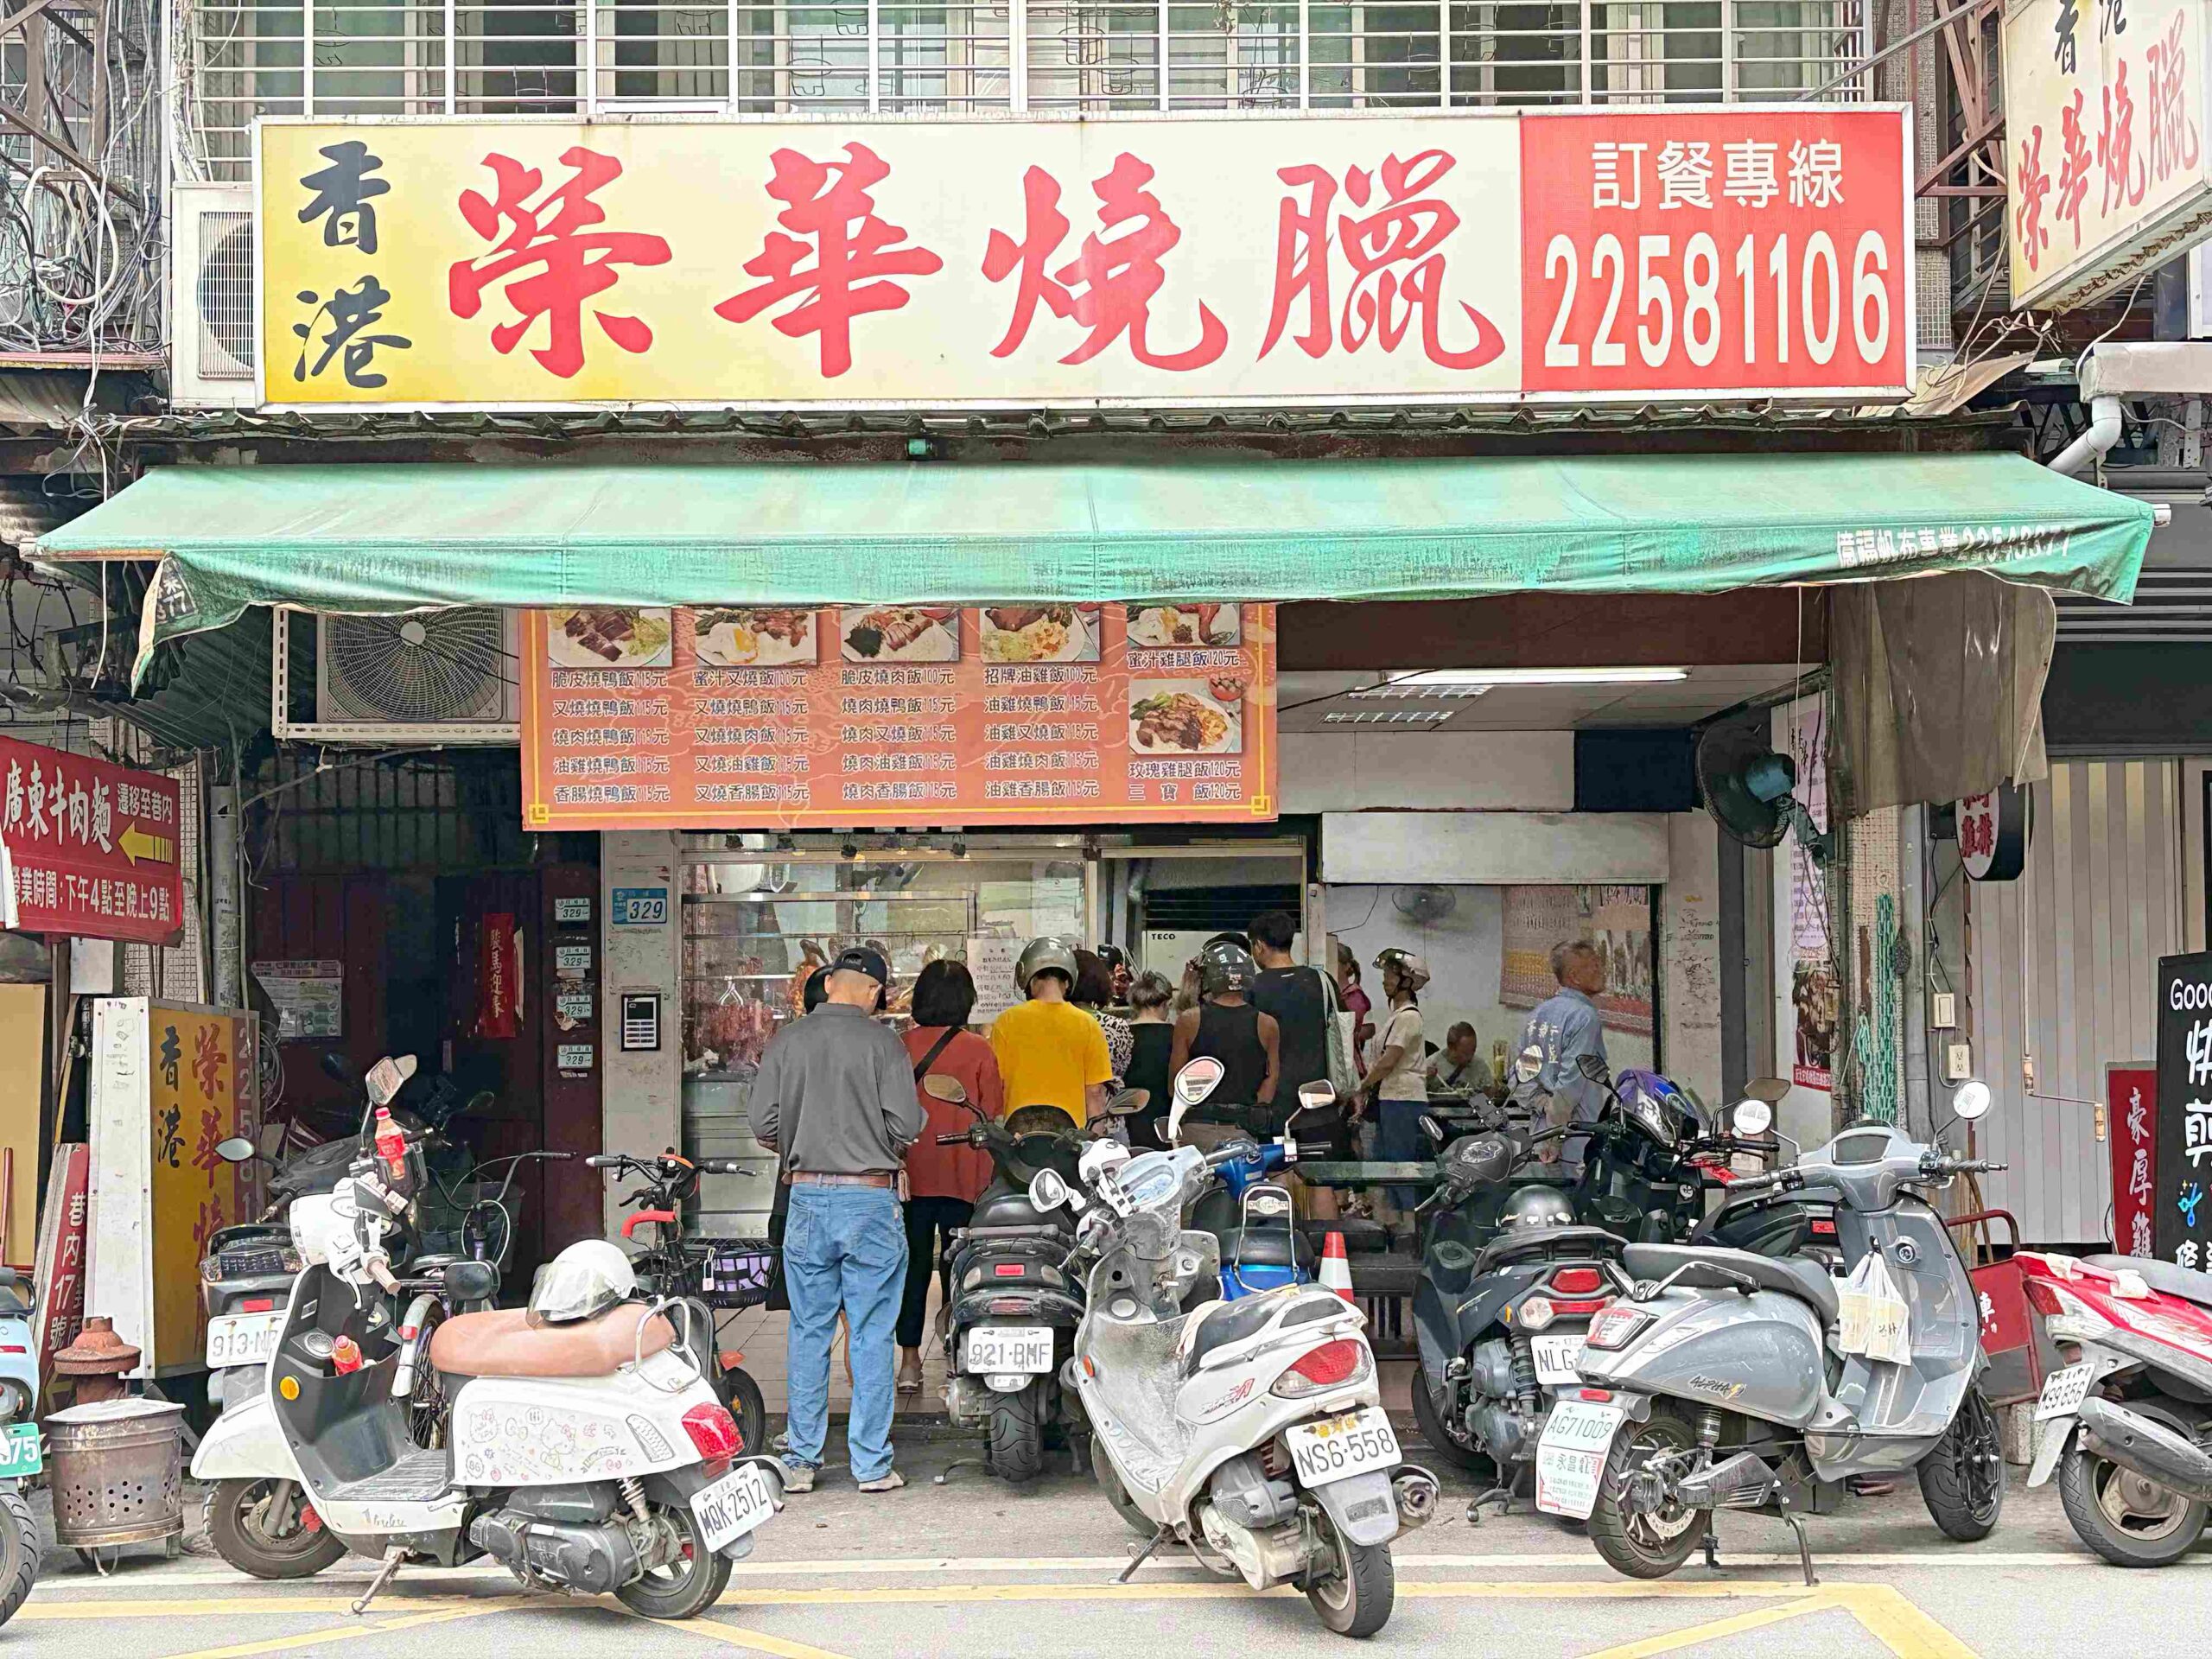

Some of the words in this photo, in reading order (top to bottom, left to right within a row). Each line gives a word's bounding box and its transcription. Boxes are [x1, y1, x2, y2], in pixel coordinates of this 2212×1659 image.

[1591, 138, 1845, 210] 訂餐專線
[292, 140, 413, 389] 香港
[1544, 229, 1890, 368] 22581106
[3, 757, 113, 855] 廣東牛肉麵
[629, 900, 664, 919] 329
[157, 1025, 186, 1168] 香港
[1548, 1414, 1613, 1440] AG71009
